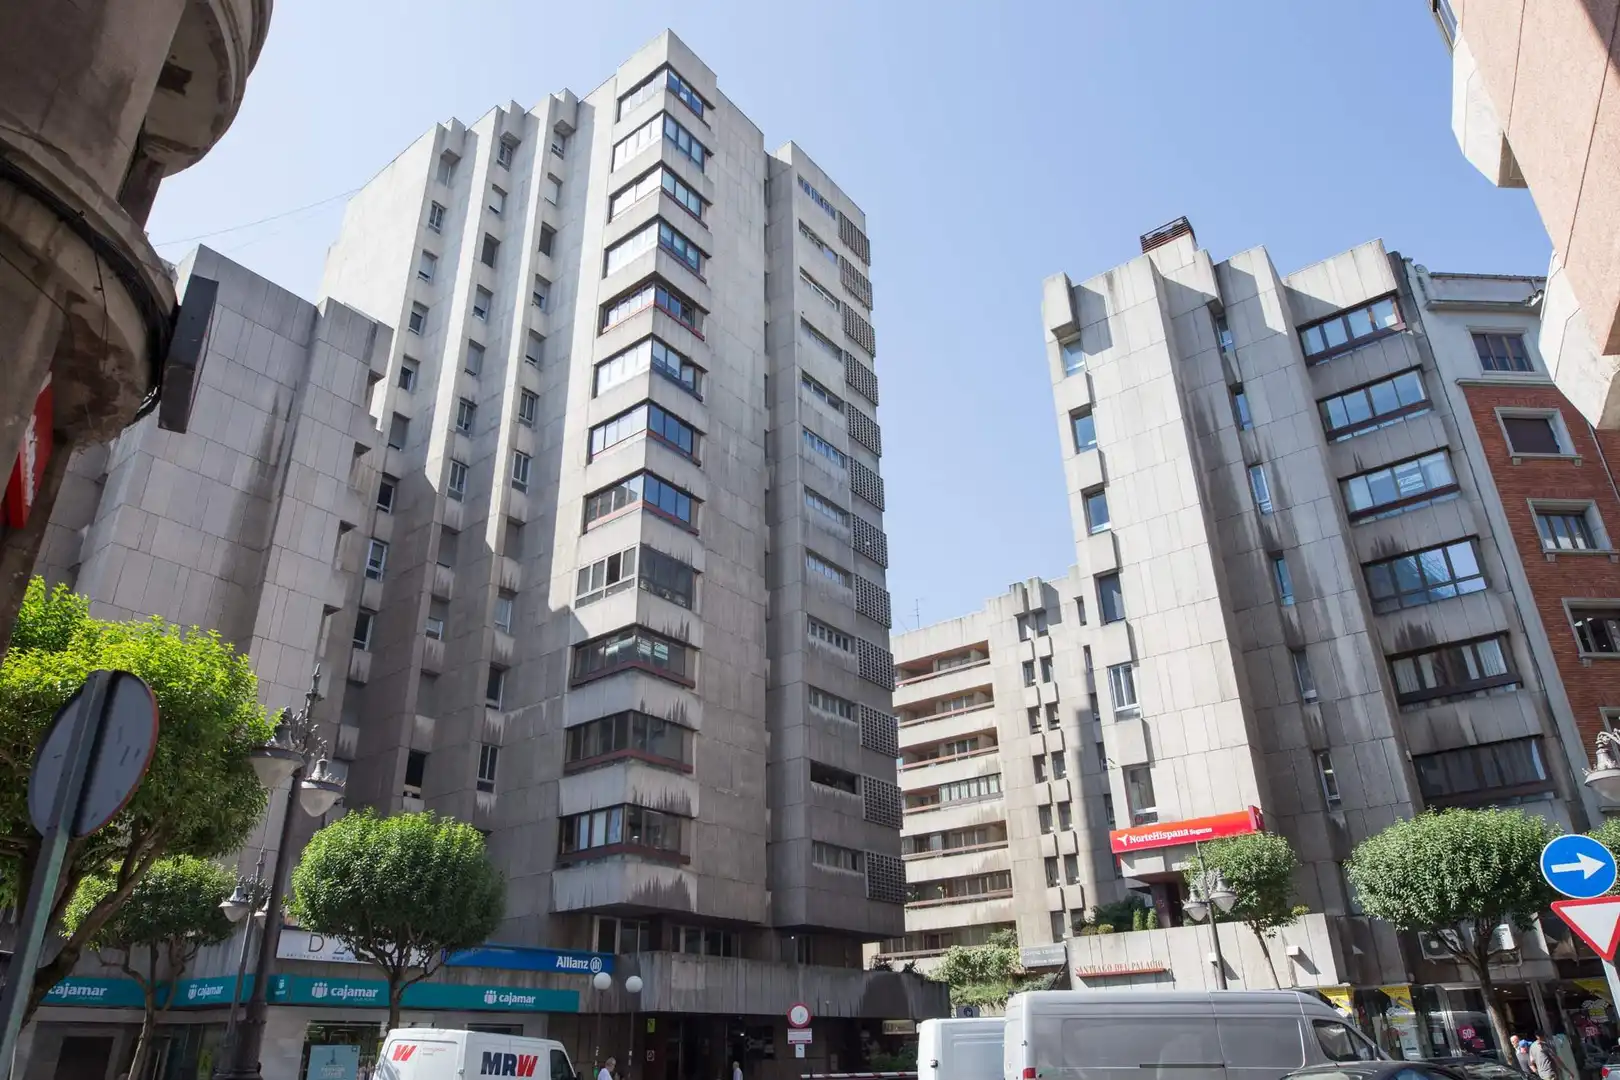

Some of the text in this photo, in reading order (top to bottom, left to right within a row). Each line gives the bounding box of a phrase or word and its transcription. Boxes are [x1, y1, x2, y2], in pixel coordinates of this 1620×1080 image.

[1129, 827, 1213, 844] NorteHispana Seguros
[556, 956, 589, 970] Allianz
[197, 984, 224, 999] cajamar
[330, 985, 379, 1000] cajamar
[499, 992, 536, 1005] cajamar
[480, 1051, 539, 1077] MRW
